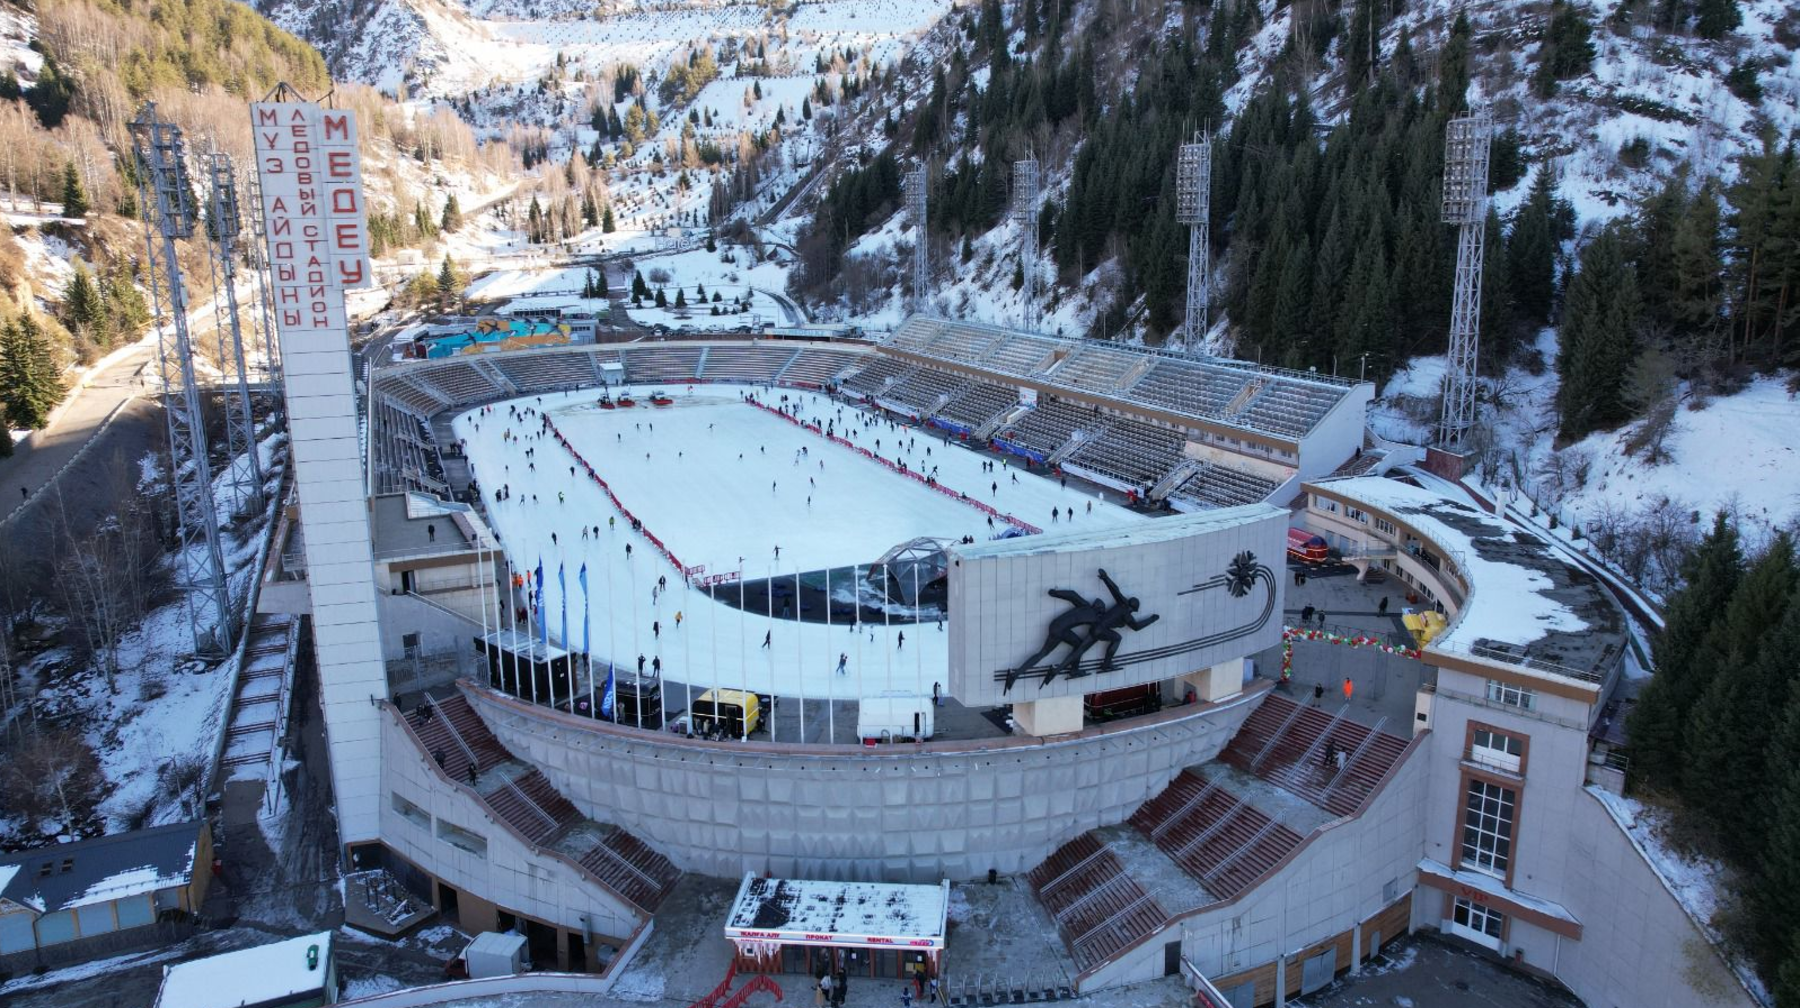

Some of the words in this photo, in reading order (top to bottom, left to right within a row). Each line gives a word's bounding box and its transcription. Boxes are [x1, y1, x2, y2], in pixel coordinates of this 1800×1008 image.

[291, 108, 316, 216] ЛЕДОВЫЙ
[324, 114, 364, 285] МЕДЕУ
[272, 195, 302, 327] АЙДЫНЫ
[302, 224, 329, 328] СТАДИОН
